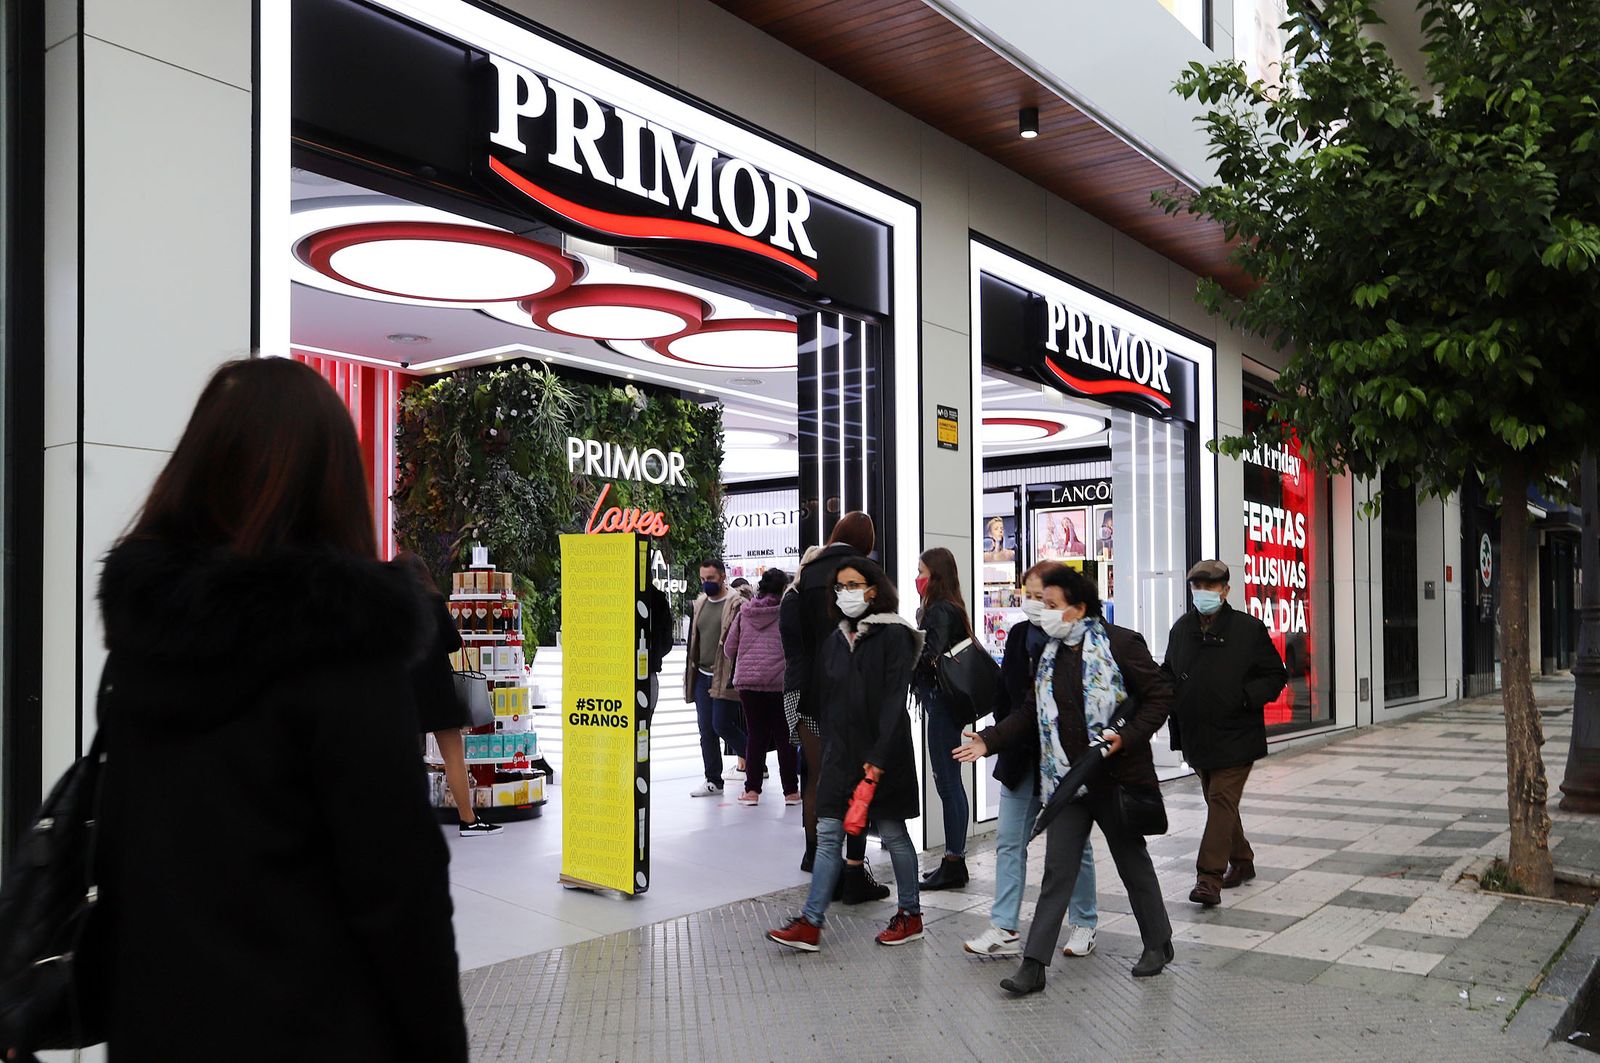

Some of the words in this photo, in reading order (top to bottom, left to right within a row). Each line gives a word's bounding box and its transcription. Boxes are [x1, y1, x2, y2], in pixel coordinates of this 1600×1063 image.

[489, 53, 817, 260] PRIMOR
[1045, 297, 1171, 394] PRIMOR
[567, 437, 687, 487] PRIMOR
[1263, 442, 1301, 486] Friday
[784, 547, 800, 555] Chl
[1243, 554, 1306, 589] CLUSIVAS
[1279, 590, 1308, 633] DÍA
[568, 712, 629, 728] GRANOS
[576, 698, 622, 712] #STOP
